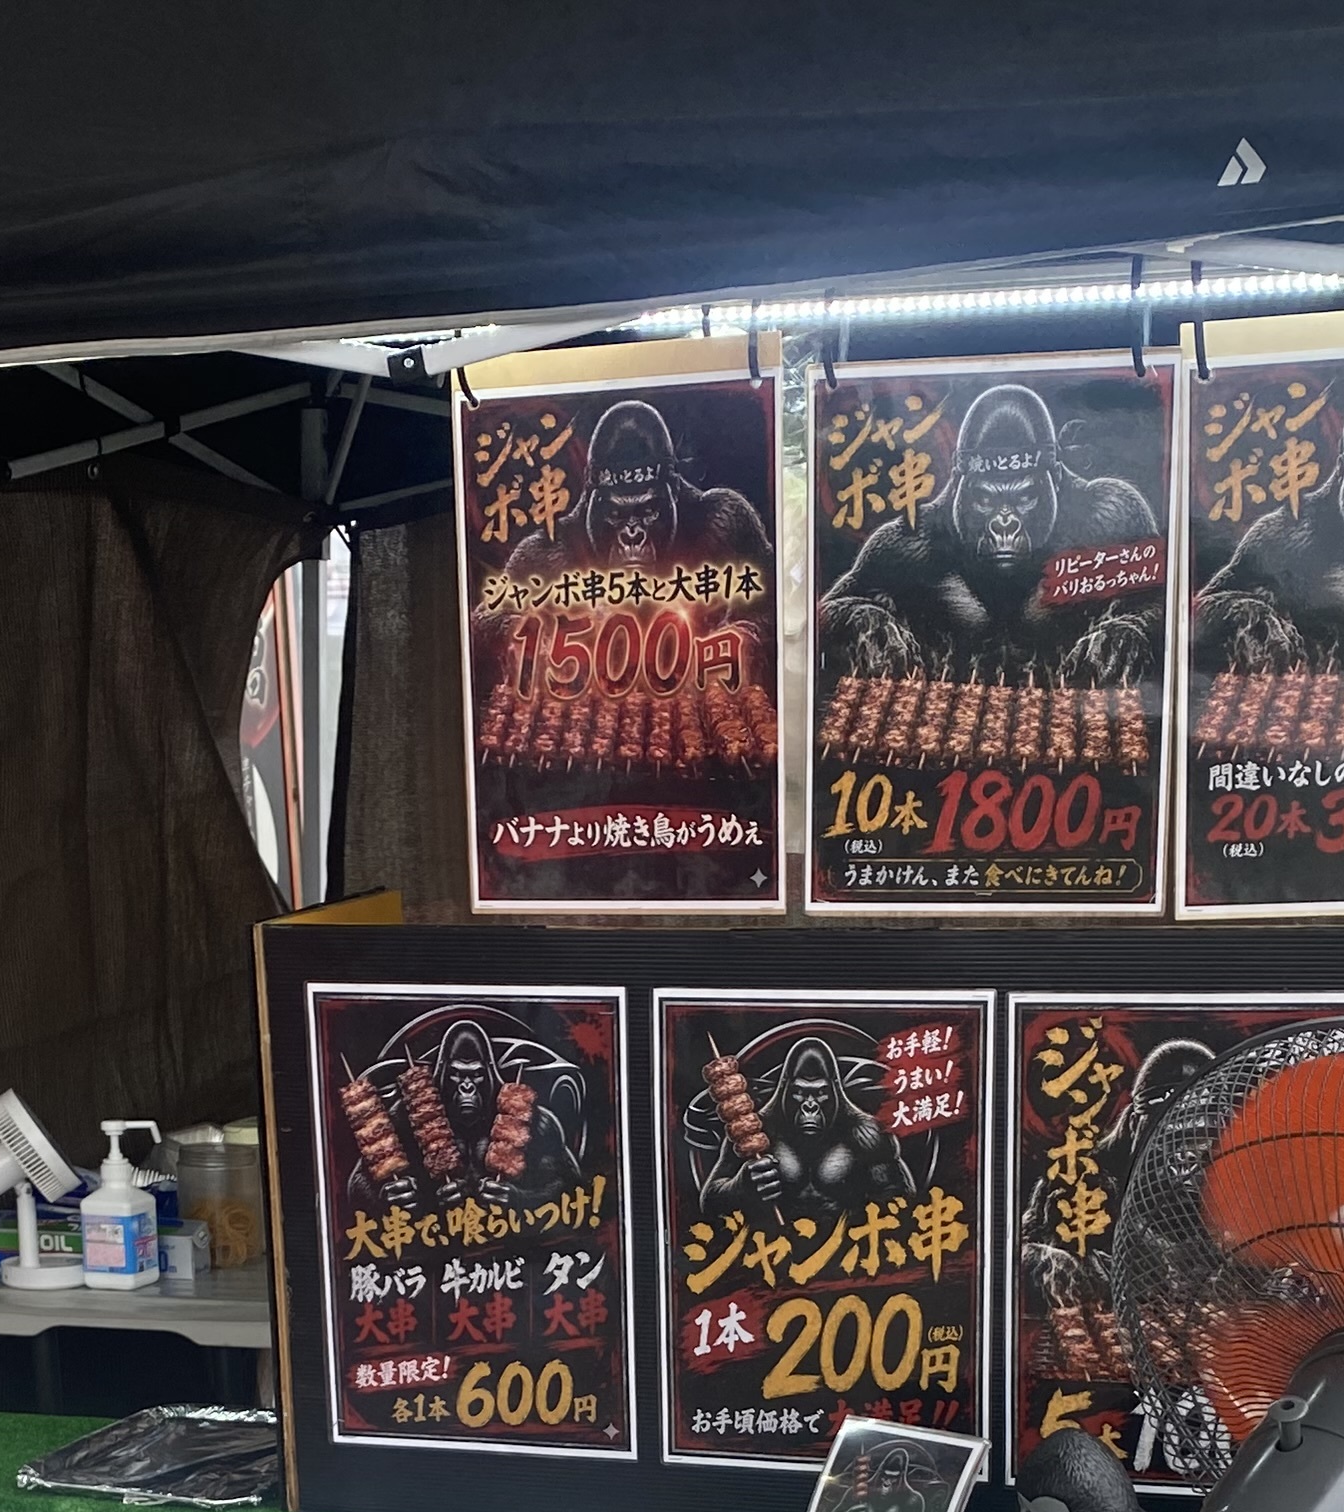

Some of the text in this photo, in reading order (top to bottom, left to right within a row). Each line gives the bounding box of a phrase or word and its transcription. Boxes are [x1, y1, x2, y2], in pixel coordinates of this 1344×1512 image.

[1052, 562, 1160, 597] バリおるっちゃん!
[1054, 545, 1156, 577] リピーターさんの
[483, 565, 764, 611] ジャンボ串5本と大串1本
[513, 611, 744, 701] 1500円
[820, 769, 1143, 856] 10本 1800円
[1207, 793, 1312, 843] 20本
[886, 1026, 954, 1061] お手軽!
[893, 1060, 954, 1095] うまい!
[891, 1090, 965, 1129] 大満足!
[1032, 1014, 1125, 1258] ジャンボ串
[683, 1186, 970, 1296] ジャンボ串
[349, 1251, 606, 1306] 豚バラ 牛カルビ タン
[353, 1288, 609, 1344] 大串 大串 大串
[355, 1356, 452, 1389] 数量限定!
[693, 1292, 961, 1401] 1本 200円
[391, 1359, 598, 1429] 各1本 600円
